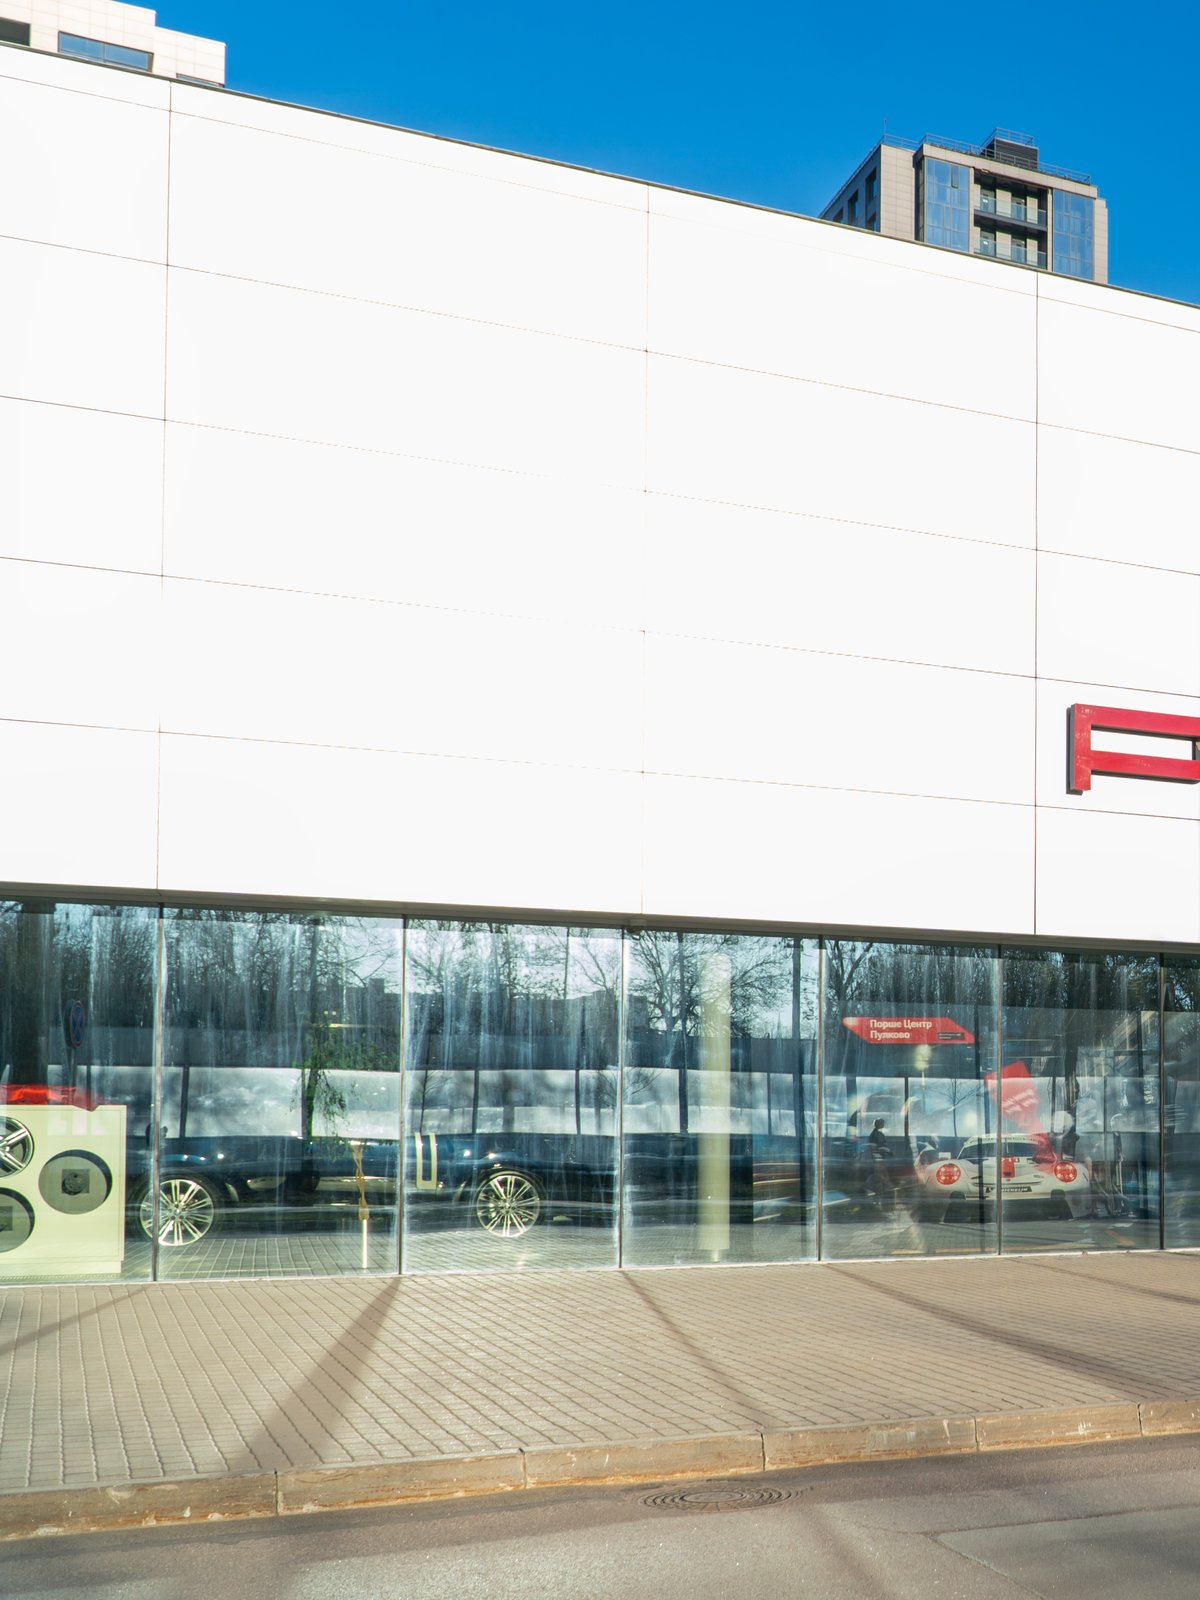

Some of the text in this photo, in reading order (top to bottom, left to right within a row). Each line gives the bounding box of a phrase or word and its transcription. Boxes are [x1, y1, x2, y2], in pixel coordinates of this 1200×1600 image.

[869, 1019, 932, 1030] Порше Центр
[869, 1030, 910, 1041] Пулково
